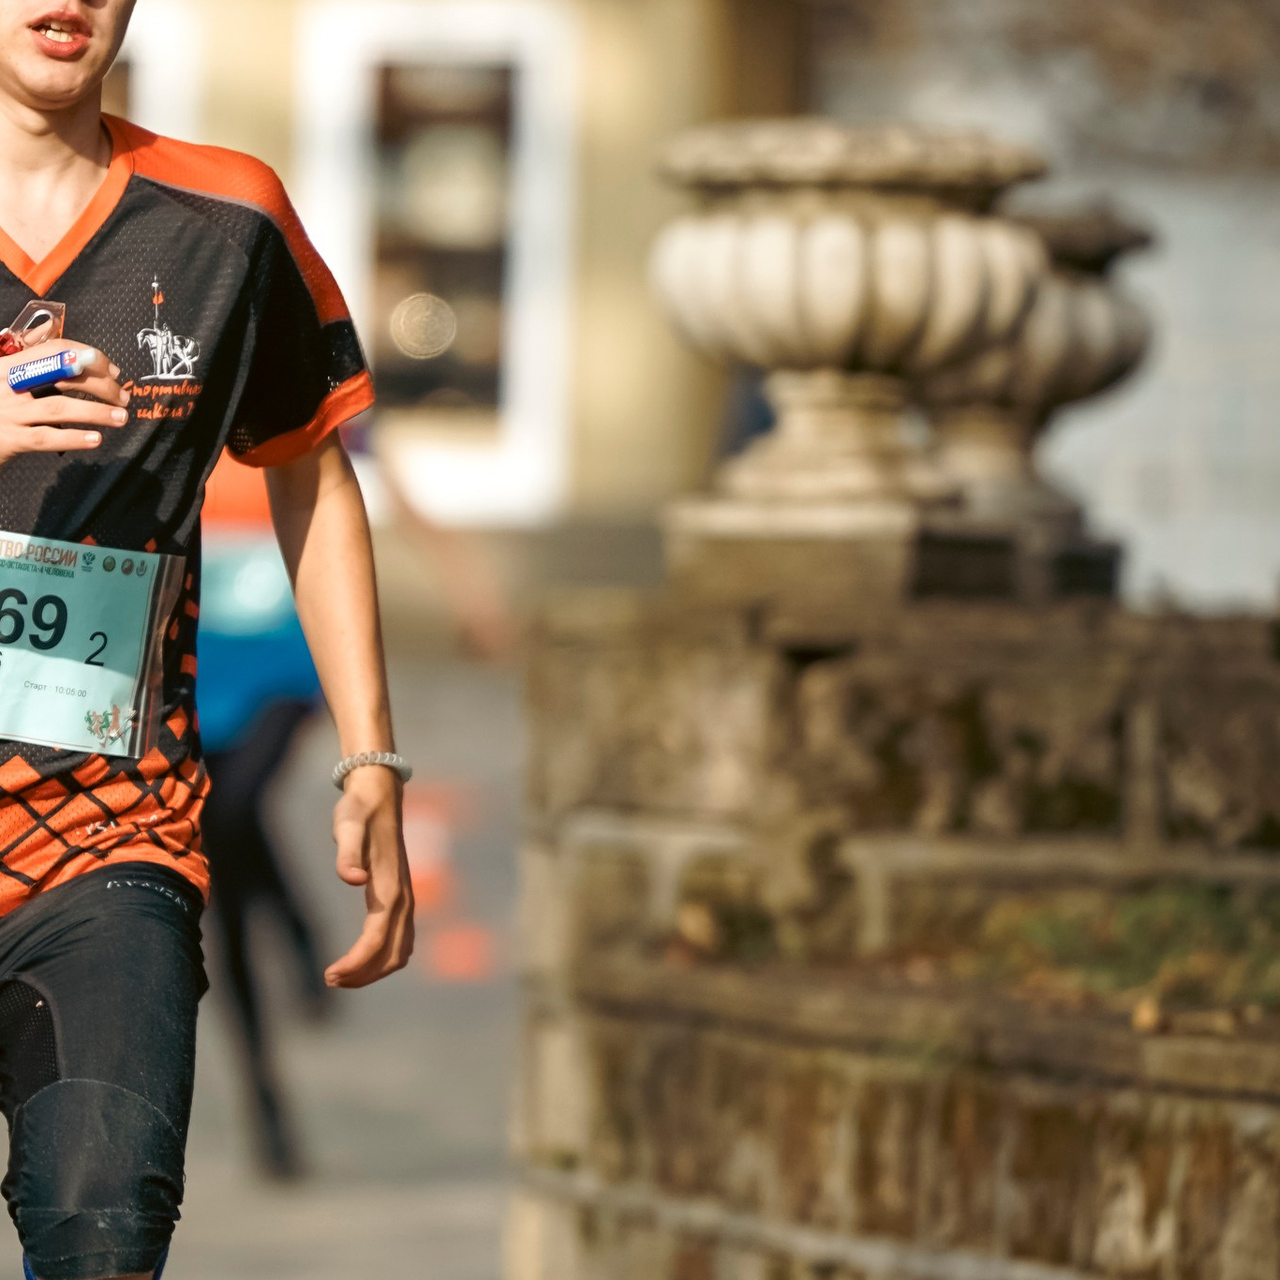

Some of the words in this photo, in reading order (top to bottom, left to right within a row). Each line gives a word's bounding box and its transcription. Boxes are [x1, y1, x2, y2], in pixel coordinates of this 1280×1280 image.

[25, 544, 79, 568] РОССИИ
[84, 631, 108, 667] 2
[23, 680, 47, 691] Старт
